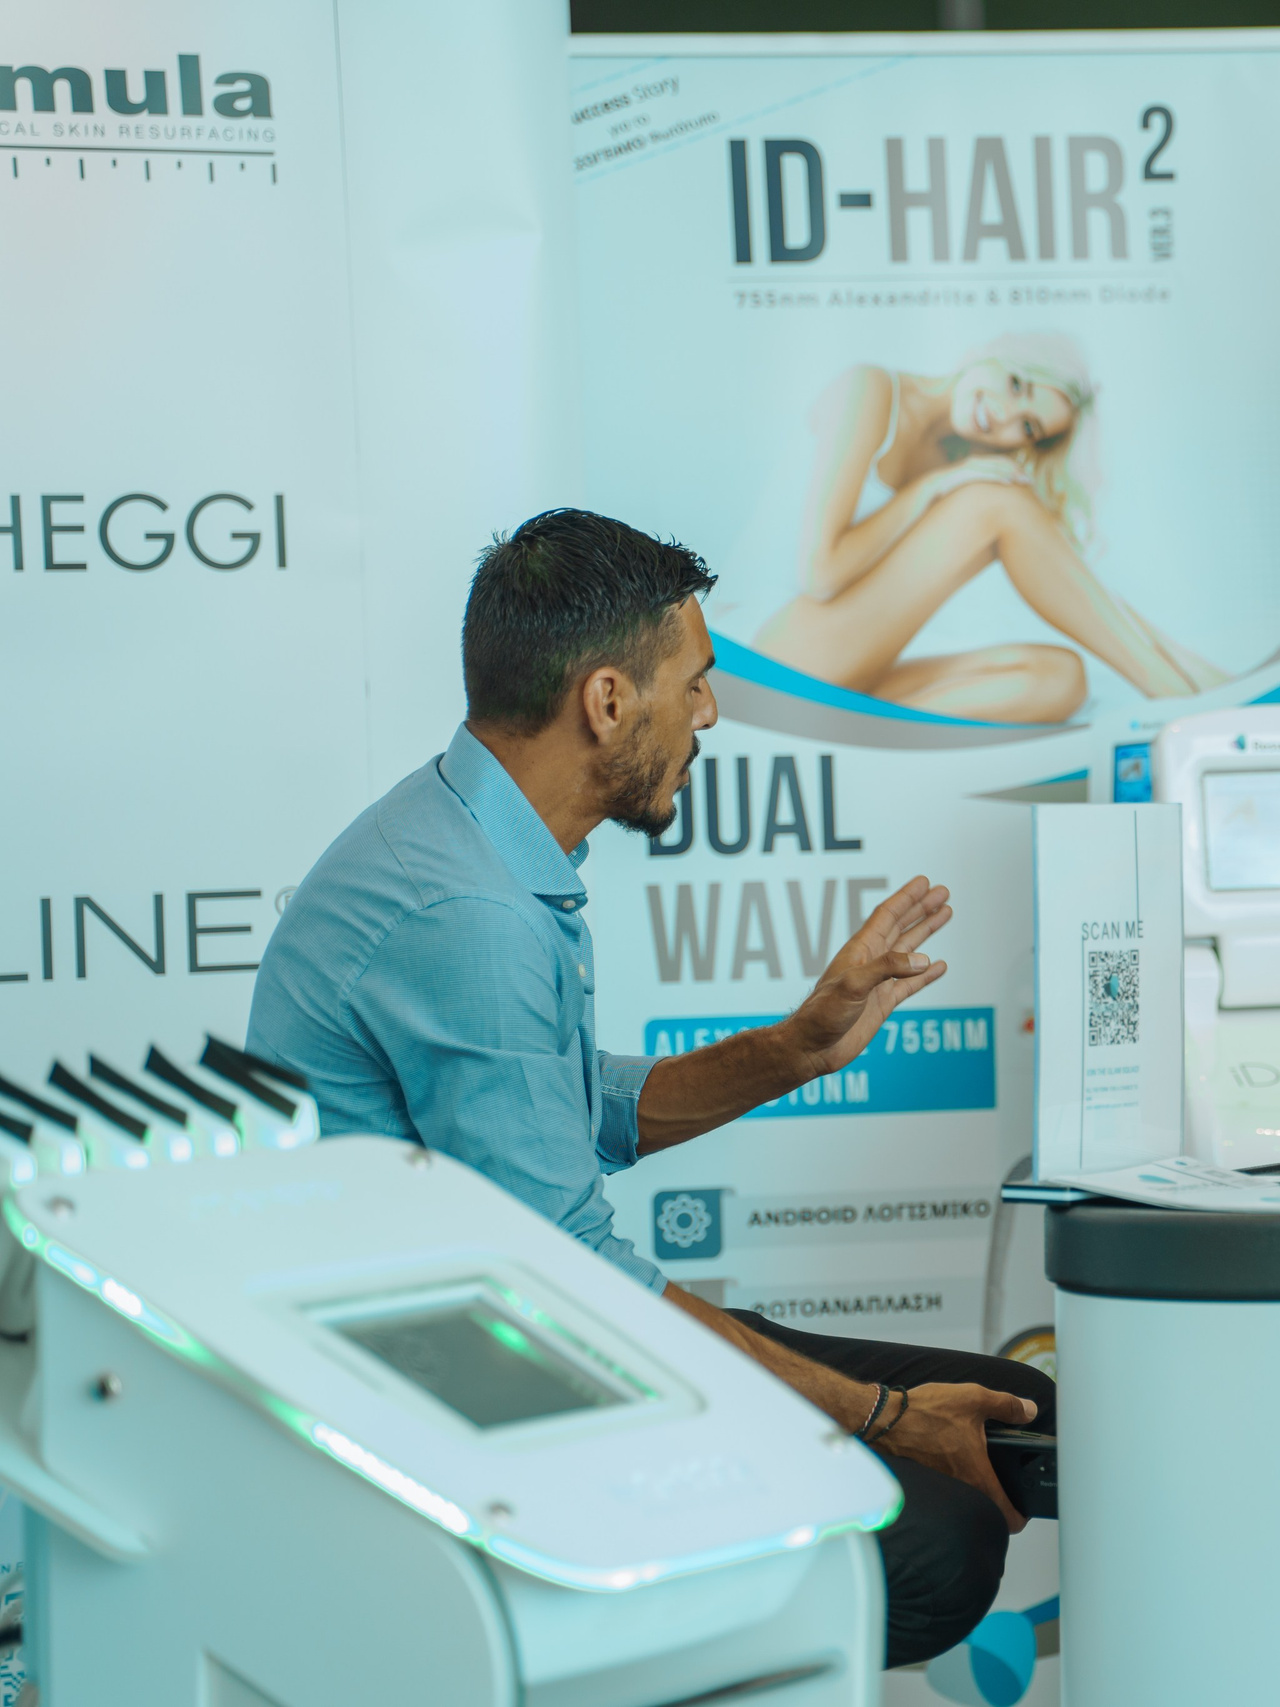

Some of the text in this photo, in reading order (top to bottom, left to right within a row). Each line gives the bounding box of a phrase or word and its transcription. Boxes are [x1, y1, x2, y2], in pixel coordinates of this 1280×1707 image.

[53, 122, 106, 138] SKIN
[118, 123, 276, 143] RESURFACING
[729, 135, 1130, 264] ID-HAIR
[1081, 920, 1144, 941] SCAN ME
[884, 1018, 989, 1055] 755NM
[749, 1206, 857, 1227] ANDROID
